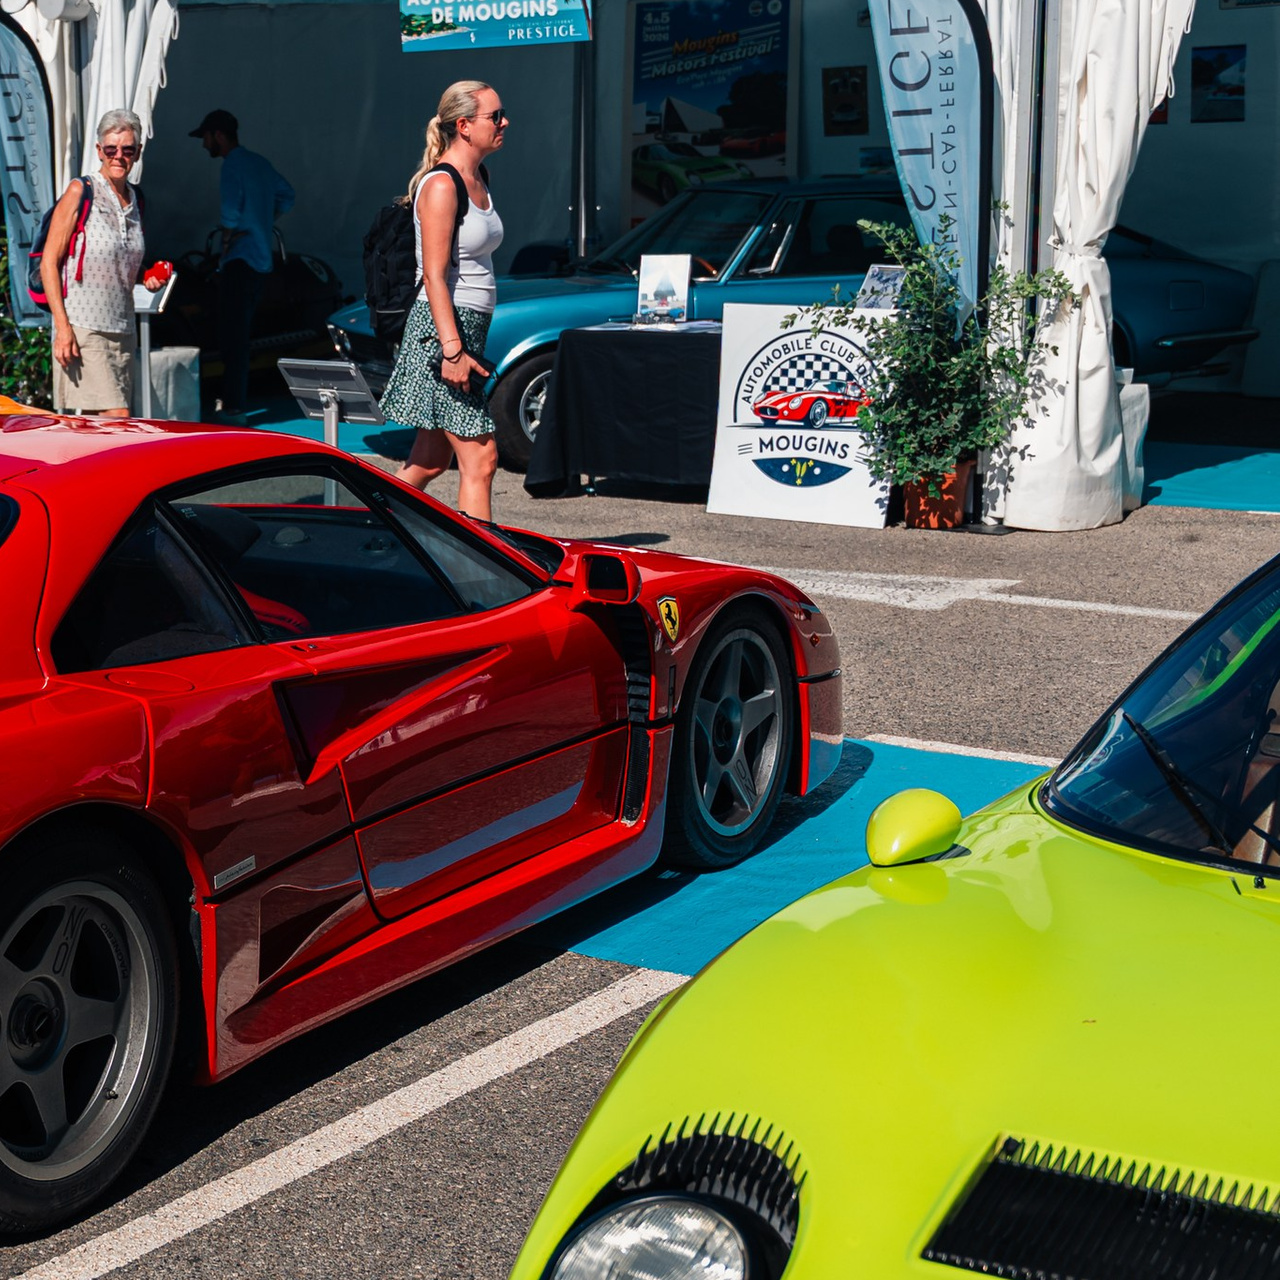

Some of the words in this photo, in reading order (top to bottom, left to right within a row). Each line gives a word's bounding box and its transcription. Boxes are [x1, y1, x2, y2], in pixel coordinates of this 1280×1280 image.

[431, 6, 454, 25] DE
[508, 24, 583, 41] PRESTIGE
[672, 28, 740, 56] Mougins
[650, 55, 707, 78] Motors
[709, 36, 774, 65] Festival
[741, 337, 813, 405] AUTOMOBILE
[819, 339, 856, 364] CLUB
[855, 363, 873, 386] DE
[758, 435, 850, 460] MOUGINS
